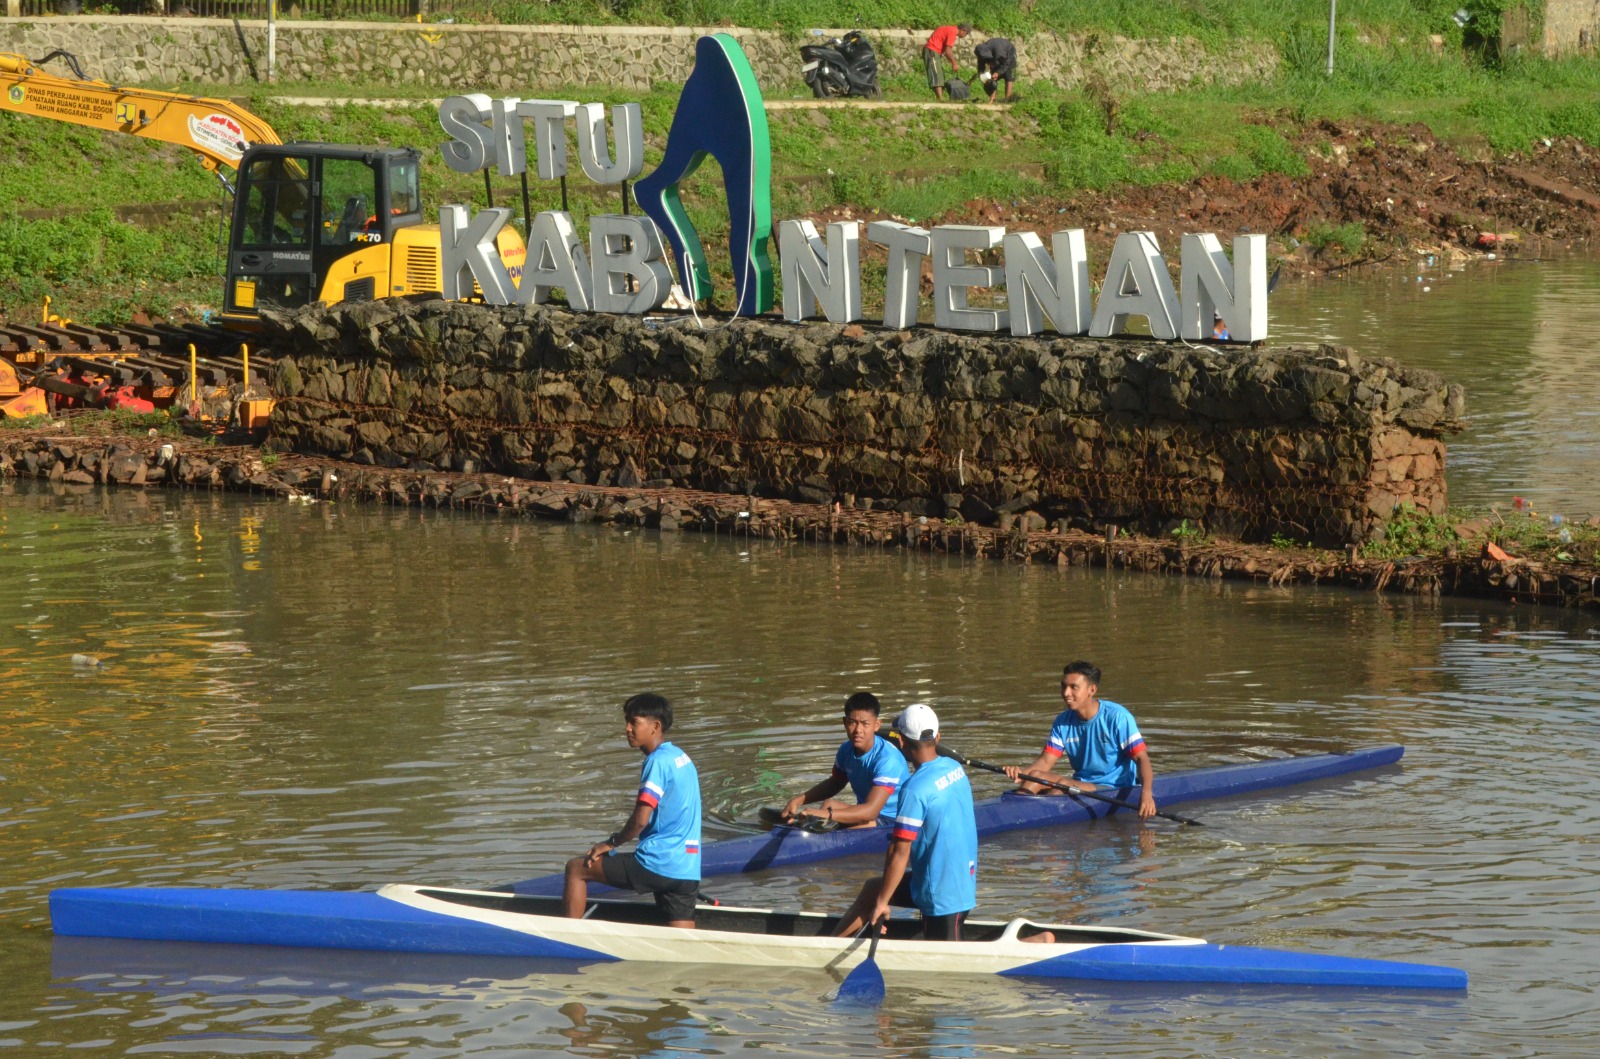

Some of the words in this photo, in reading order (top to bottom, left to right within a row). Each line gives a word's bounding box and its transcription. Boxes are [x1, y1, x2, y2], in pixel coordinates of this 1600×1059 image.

[26, 94, 55, 104] PENATAAN
[57, 99, 77, 108] RUANG
[78, 103, 91, 111] KAB.
[93, 105, 113, 114] BOGOR
[28, 87, 45, 96] DINAS
[47, 90, 80, 101] PEKERJAAN
[81, 96, 99, 104] UMUM
[35, 103, 54, 112] TAHUN
[56, 107, 88, 118] ANGGARAN
[89, 112, 103, 120] 2025
[439, 93, 644, 184] SITU
[357, 232, 382, 242] PC70
[272, 252, 310, 261] KOMATSU
